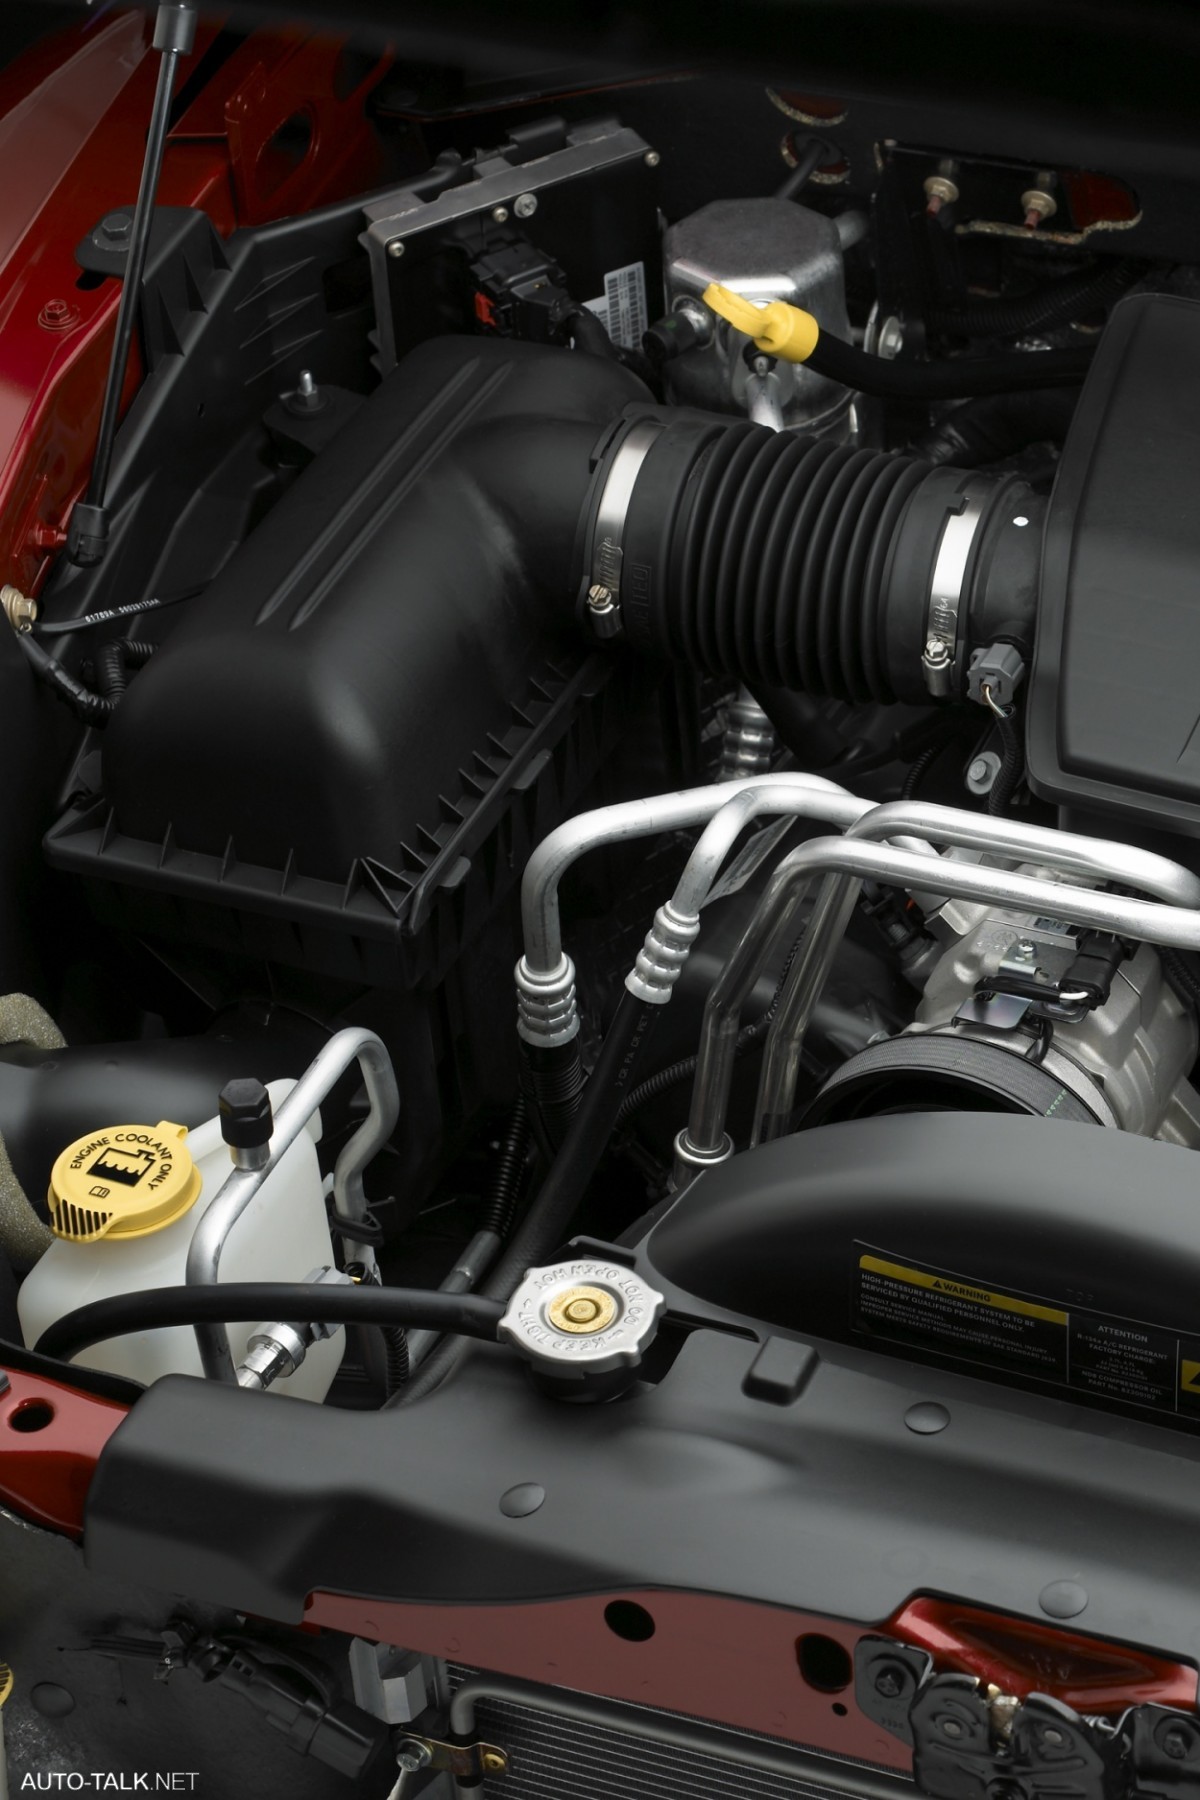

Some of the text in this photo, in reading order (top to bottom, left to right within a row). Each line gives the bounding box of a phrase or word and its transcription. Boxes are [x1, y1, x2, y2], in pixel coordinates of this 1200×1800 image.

[70, 1133, 174, 1191] ENGINE COOLANT ONLY
[862, 1274, 1034, 1328] HIGH-PRESSURE REFRIGERANT SYSTEM TO BE
[862, 1283, 897, 1298] SERVICED
[900, 1293, 908, 1301] BY
[912, 1297, 952, 1313] QUALIFIED
[955, 1308, 1000, 1326] PERSONNEL
[944, 1284, 991, 1302] WARNING
[1098, 1325, 1148, 1344] ATTENTION
